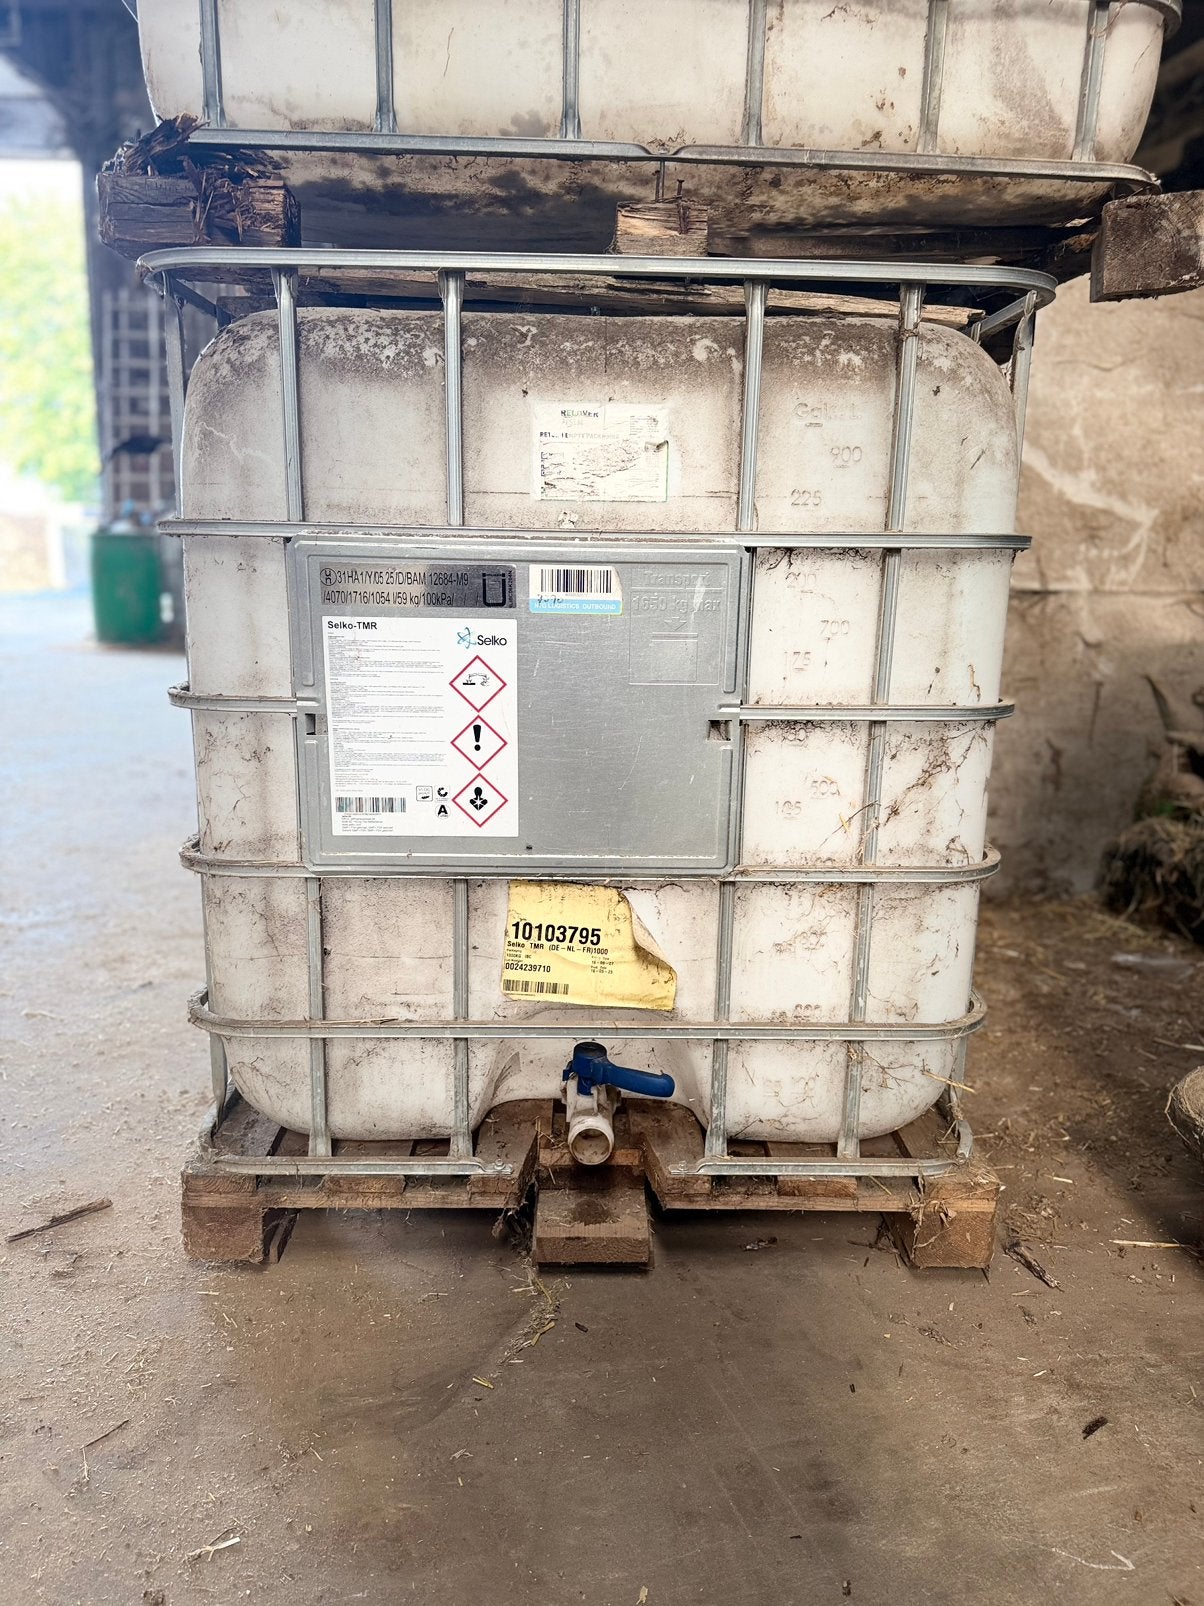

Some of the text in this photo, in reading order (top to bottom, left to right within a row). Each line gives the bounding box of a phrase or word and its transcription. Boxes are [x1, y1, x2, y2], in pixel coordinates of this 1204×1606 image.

[830, 446, 863, 462] 900
[790, 489, 822, 506] 225
[429, 572, 469, 586] 12684-M9
[326, 620, 378, 630] Selko-TMR
[818, 619, 851, 635] 700
[477, 634, 508, 648] Selko
[511, 921, 602, 946] 10103795
[507, 940, 525, 949] Selko
[530, 942, 545, 950] TMR
[505, 962, 551, 973] 0024239710
